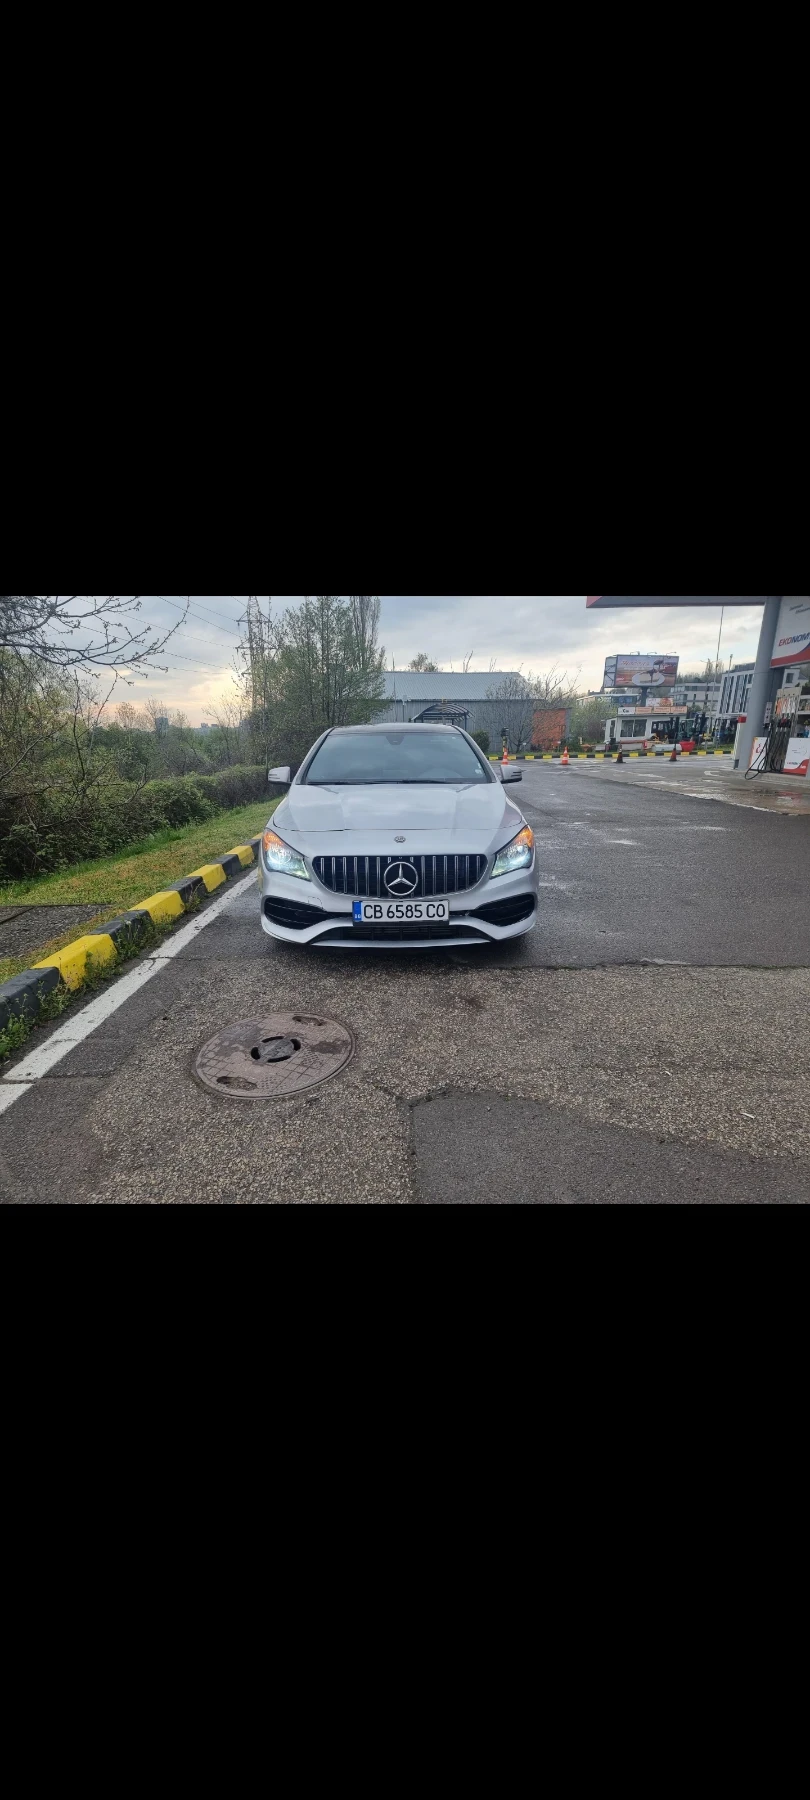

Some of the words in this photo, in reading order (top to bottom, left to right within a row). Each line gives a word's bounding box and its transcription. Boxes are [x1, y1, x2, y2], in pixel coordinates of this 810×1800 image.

[363, 904, 383, 919] CB
[386, 904, 423, 919] 6585
[426, 903, 446, 918] CO
